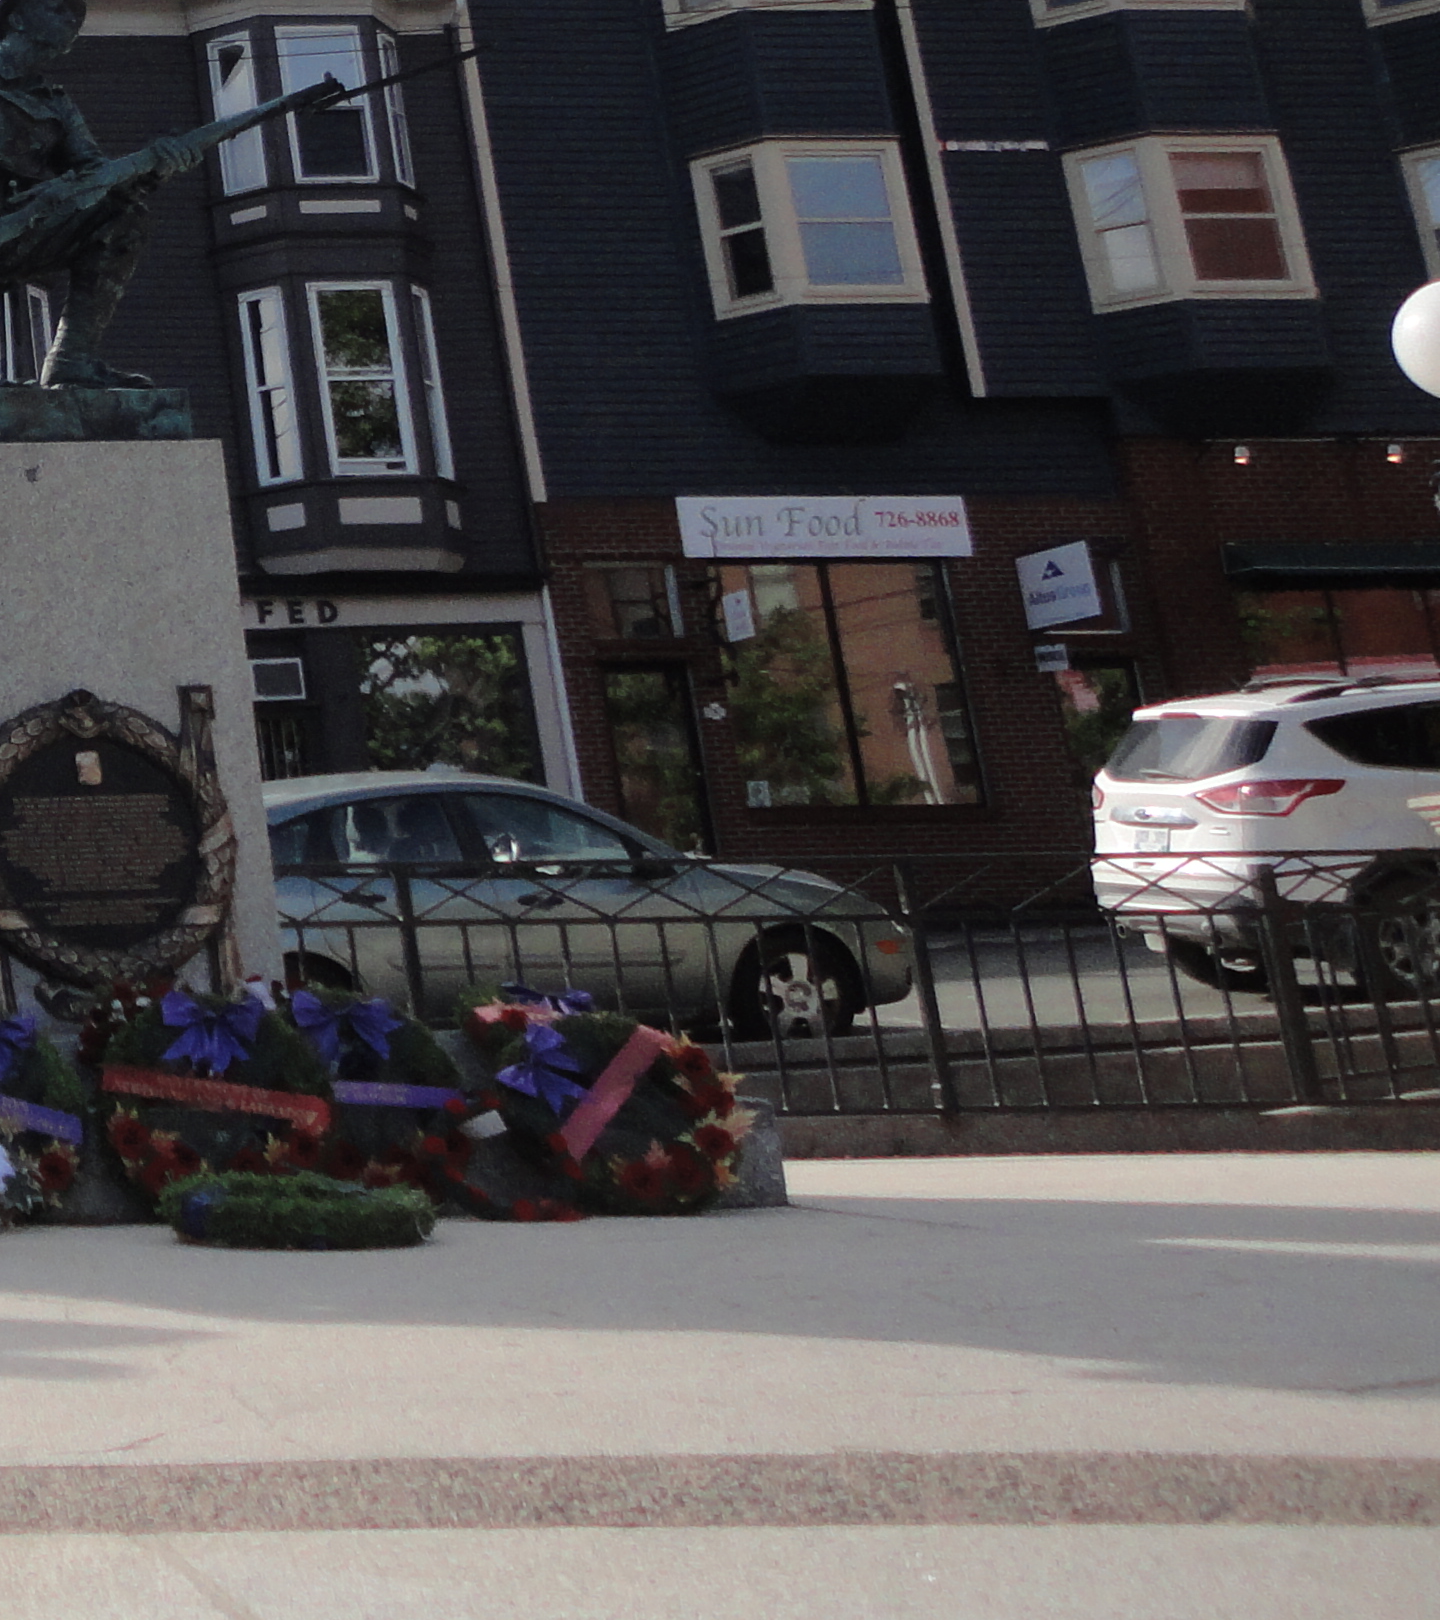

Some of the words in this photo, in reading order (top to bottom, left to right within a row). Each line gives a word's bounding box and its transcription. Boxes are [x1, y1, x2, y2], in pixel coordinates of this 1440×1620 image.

[700, 506, 764, 538] Sun
[776, 499, 865, 538] Food
[874, 510, 960, 528] 726-8868
[255, 599, 339, 625] FED
